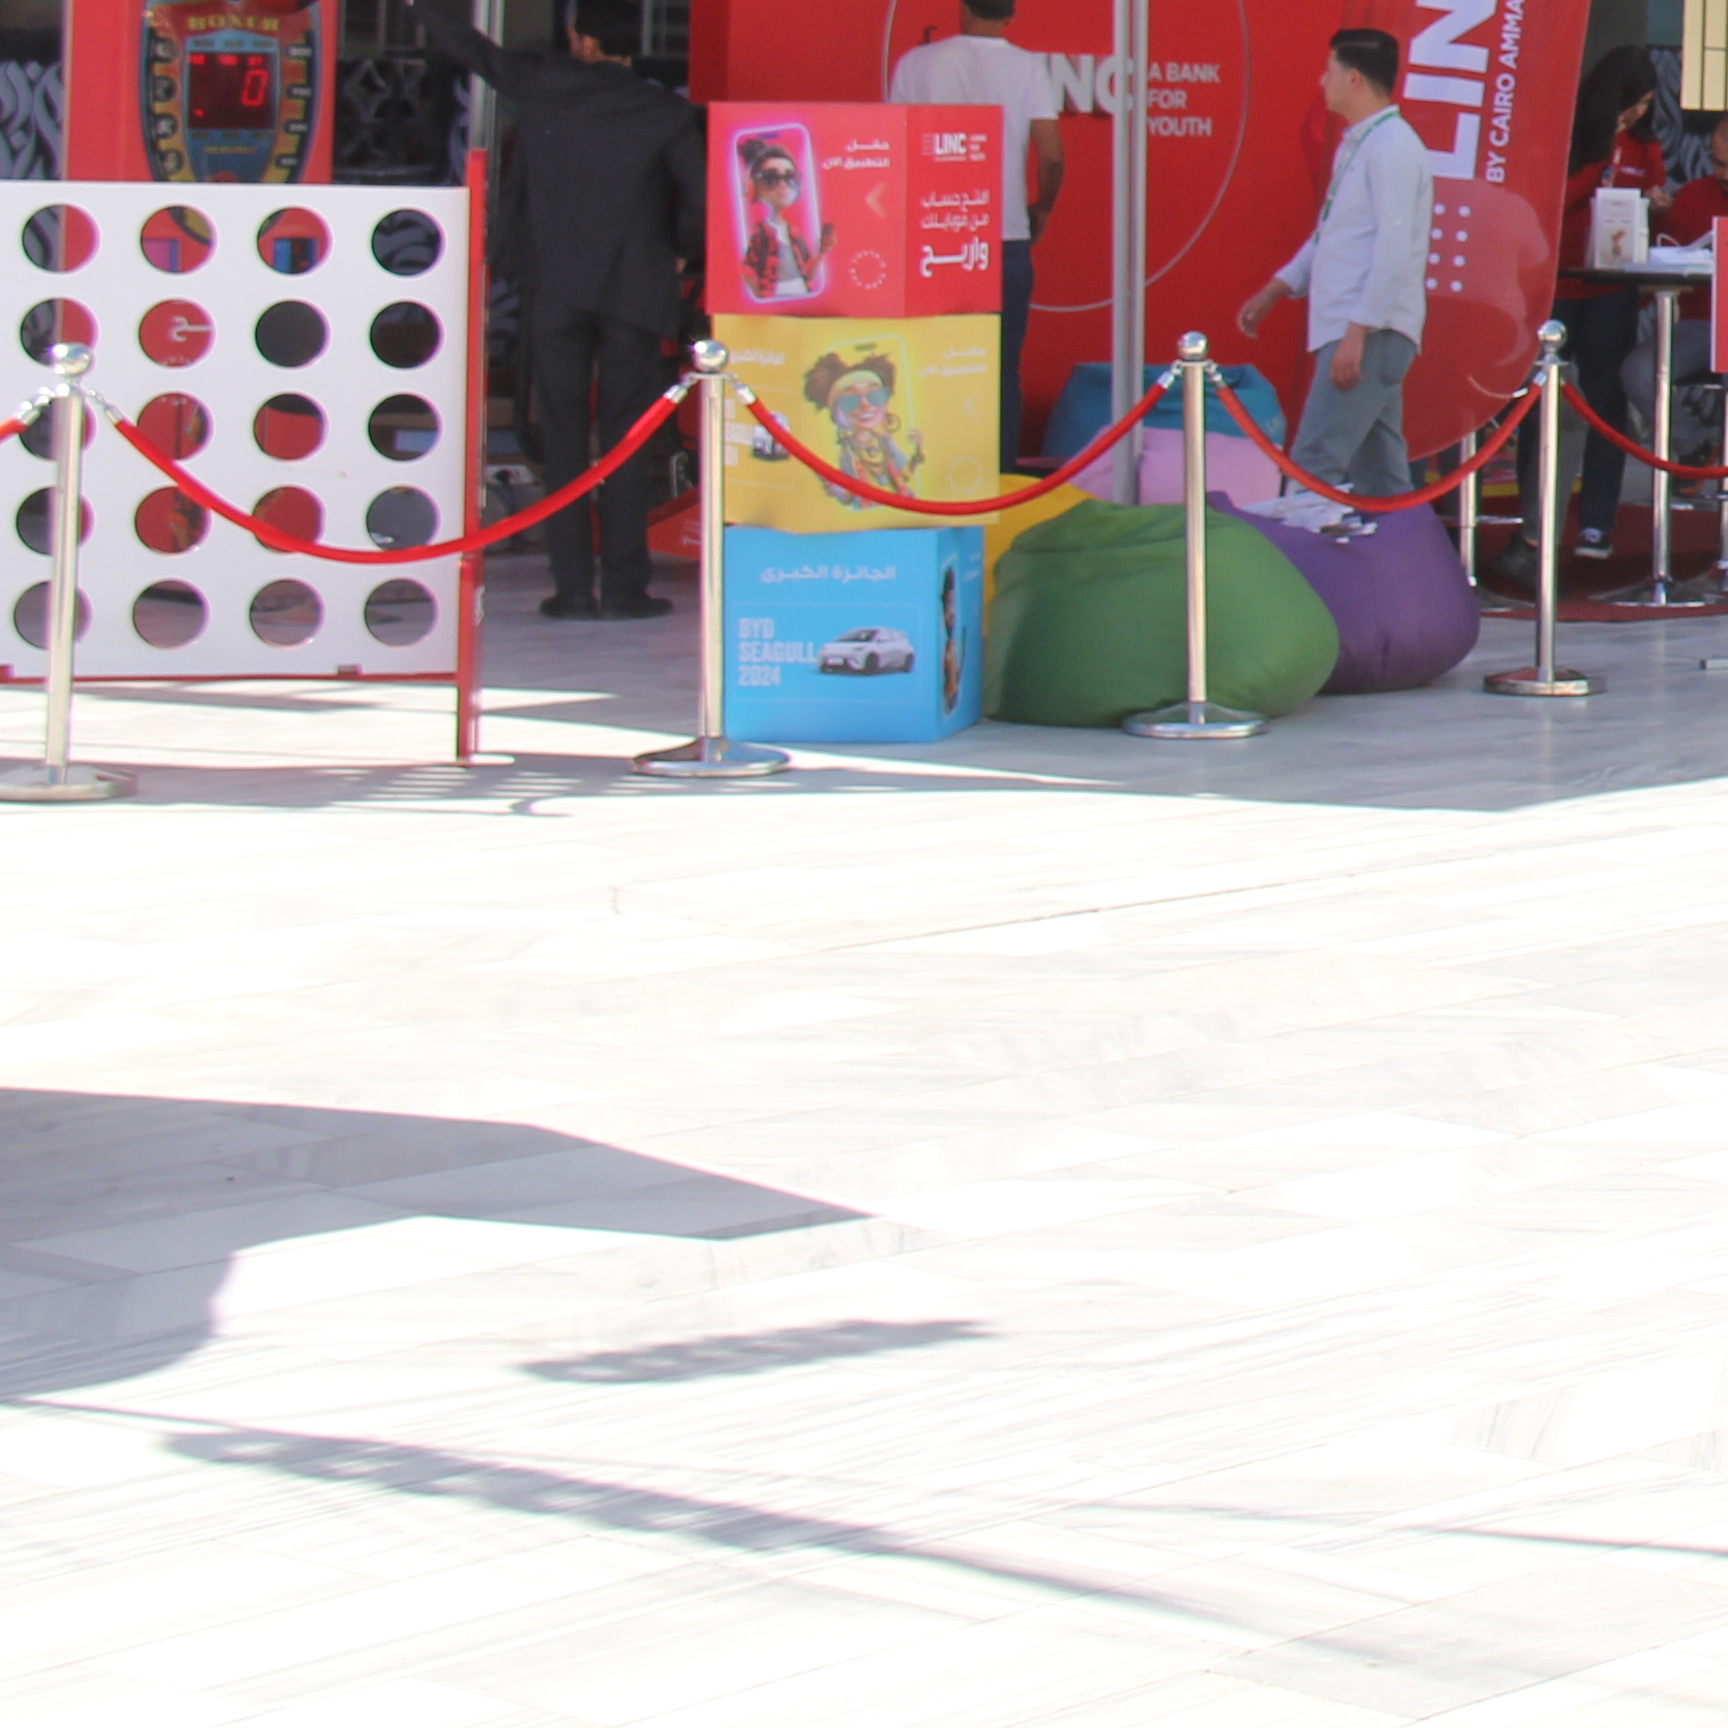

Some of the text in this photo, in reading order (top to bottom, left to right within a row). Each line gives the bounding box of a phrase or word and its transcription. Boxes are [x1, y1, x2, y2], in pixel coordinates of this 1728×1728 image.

[1166, 63, 1221, 83] BANK
[241, 69, 269, 106] 0
[1149, 89, 1187, 109] FOR
[1488, 73, 1516, 149] CAIRO
[1148, 117, 1212, 137] YOUTH
[934, 132, 967, 155] LINC
[1485, 152, 1506, 184] BY
[738, 618, 775, 639] BYD
[738, 641, 817, 663] SEAGULL
[737, 666, 781, 687] 2024
